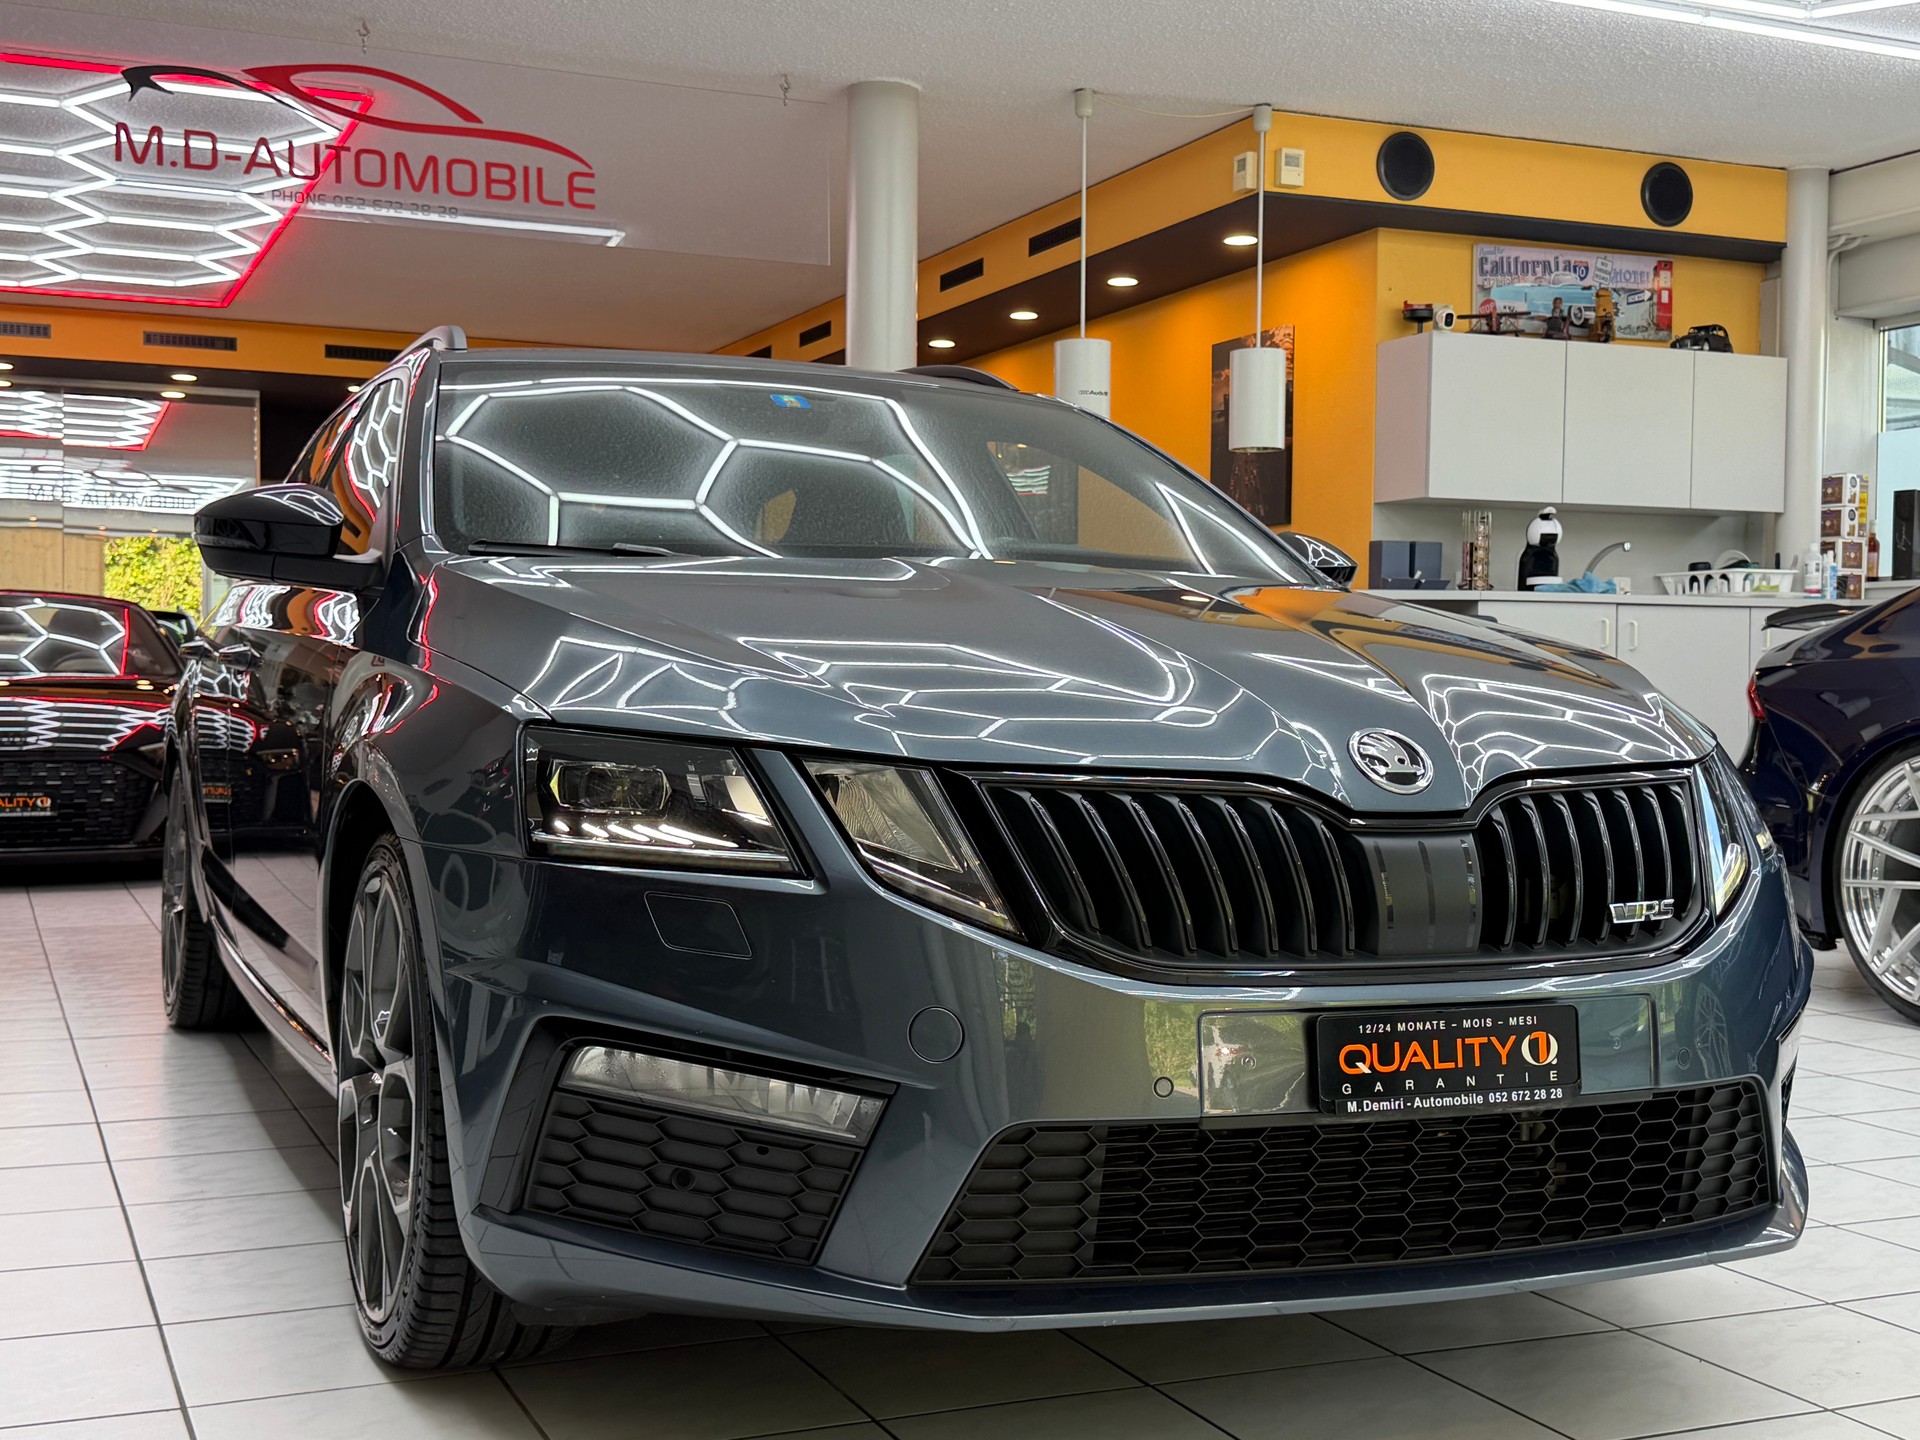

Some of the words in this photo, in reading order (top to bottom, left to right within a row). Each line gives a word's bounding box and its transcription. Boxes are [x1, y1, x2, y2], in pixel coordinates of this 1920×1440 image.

[114, 122, 596, 209] M.D-AUTOMOBILE
[271, 189, 328, 206] PHONE
[333, 195, 366, 208] 052
[410, 203, 431, 216] 28
[438, 205, 459, 218] 28
[1479, 255, 1572, 277] California
[1575, 266, 1586, 278] 10
[1358, 1023, 1391, 1034] 12/24
[1397, 1020, 1446, 1032] MONATE
[1462, 1017, 1493, 1028] MOIS
[1509, 1016, 1538, 1026] MESI
[1338, 1035, 1517, 1075] QUALITY
[1413, 1094, 1484, 1109] Automobile
[1488, 1091, 1508, 1103] 052
[1511, 1090, 1531, 1102] 672
[1533, 1089, 1547, 1101] 28
[1549, 1088, 1563, 1099] 28
